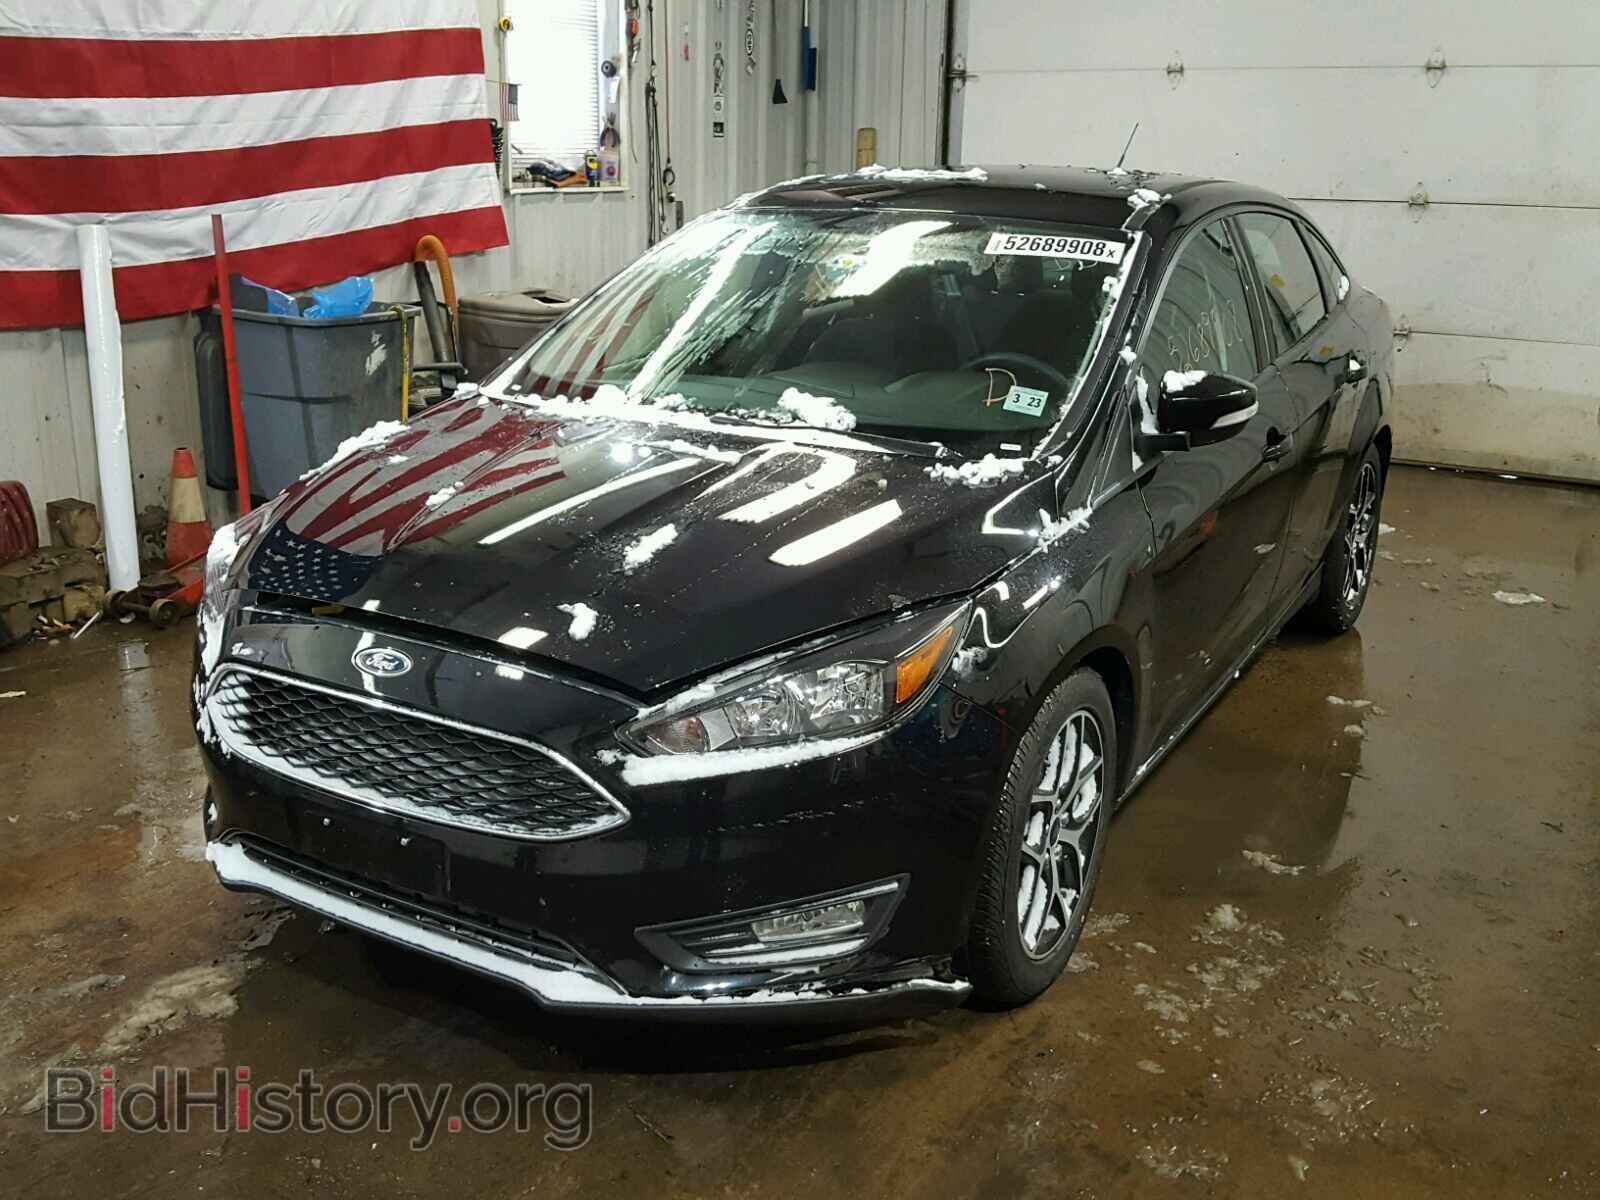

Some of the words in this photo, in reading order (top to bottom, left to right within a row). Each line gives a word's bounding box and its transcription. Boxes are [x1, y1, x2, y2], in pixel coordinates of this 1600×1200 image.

[1012, 393, 1021, 404] 3
[1027, 396, 1042, 408] 23
[366, 652, 401, 670] Ford
